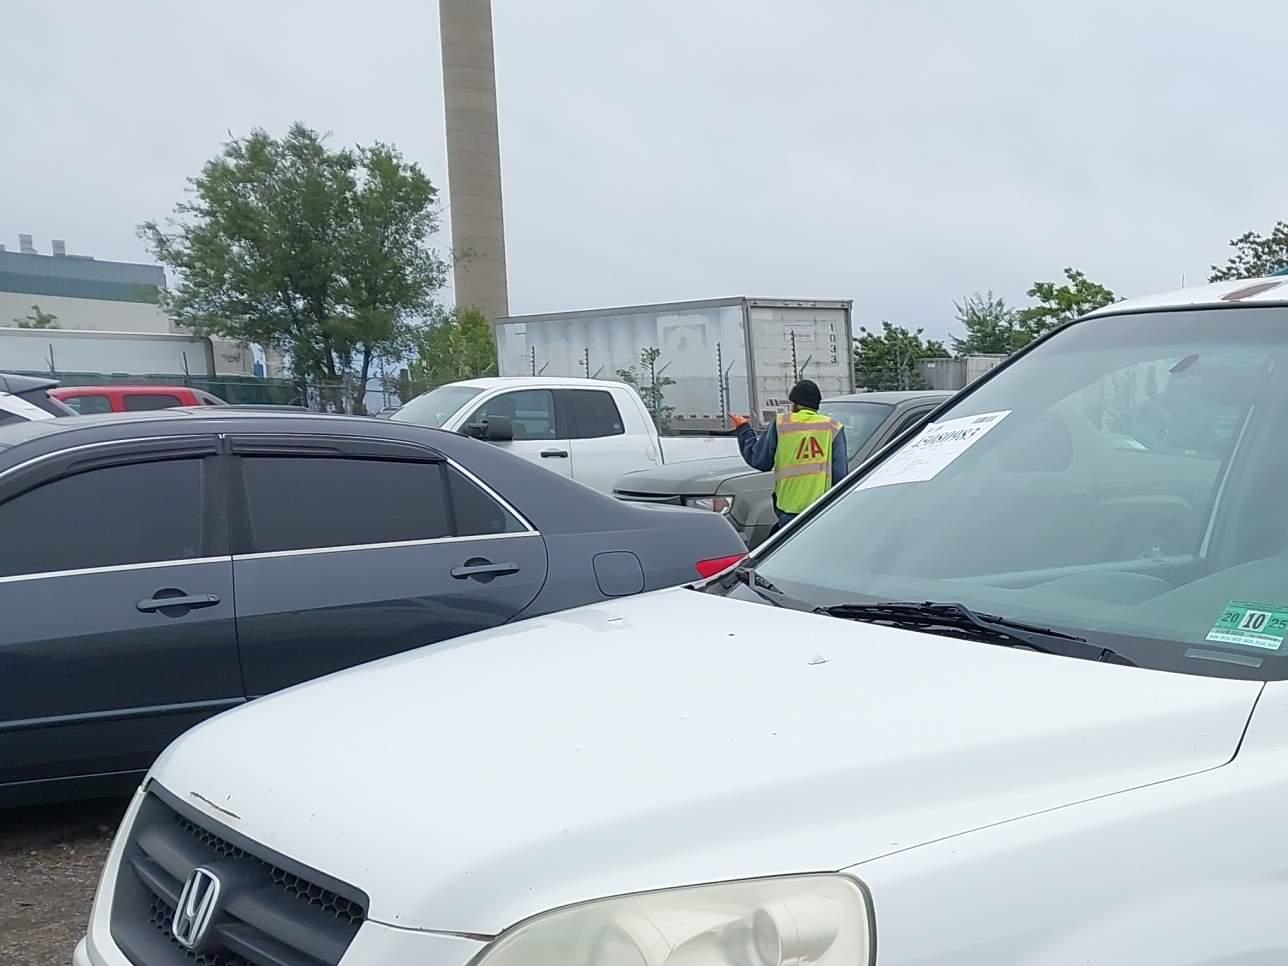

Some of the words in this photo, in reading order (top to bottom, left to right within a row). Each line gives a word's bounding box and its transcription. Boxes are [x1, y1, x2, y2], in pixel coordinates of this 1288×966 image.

[1221, 612, 1240, 623] 20
[1242, 612, 1266, 630] 10
[1269, 618, 1288, 630] 25
